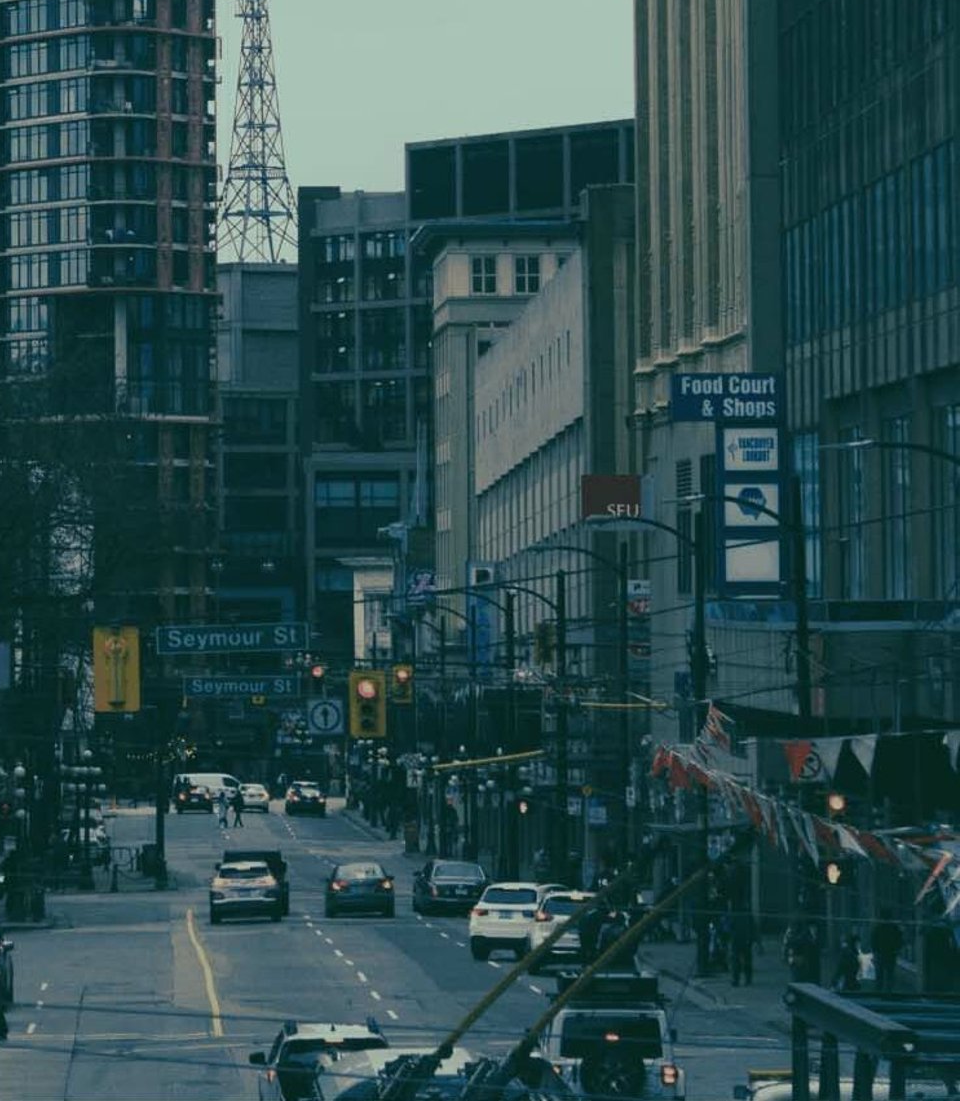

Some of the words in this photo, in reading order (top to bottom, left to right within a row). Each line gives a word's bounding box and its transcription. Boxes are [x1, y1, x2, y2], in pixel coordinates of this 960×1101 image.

[681, 376, 723, 395] Food
[728, 375, 775, 394] Court
[701, 399, 714, 417] &
[722, 398, 776, 418] Shops
[606, 503, 640, 518] SFU
[167, 630, 261, 650] Seymour
[273, 626, 297, 645] St
[191, 678, 265, 695] Seymour
[273, 678, 293, 694] St
